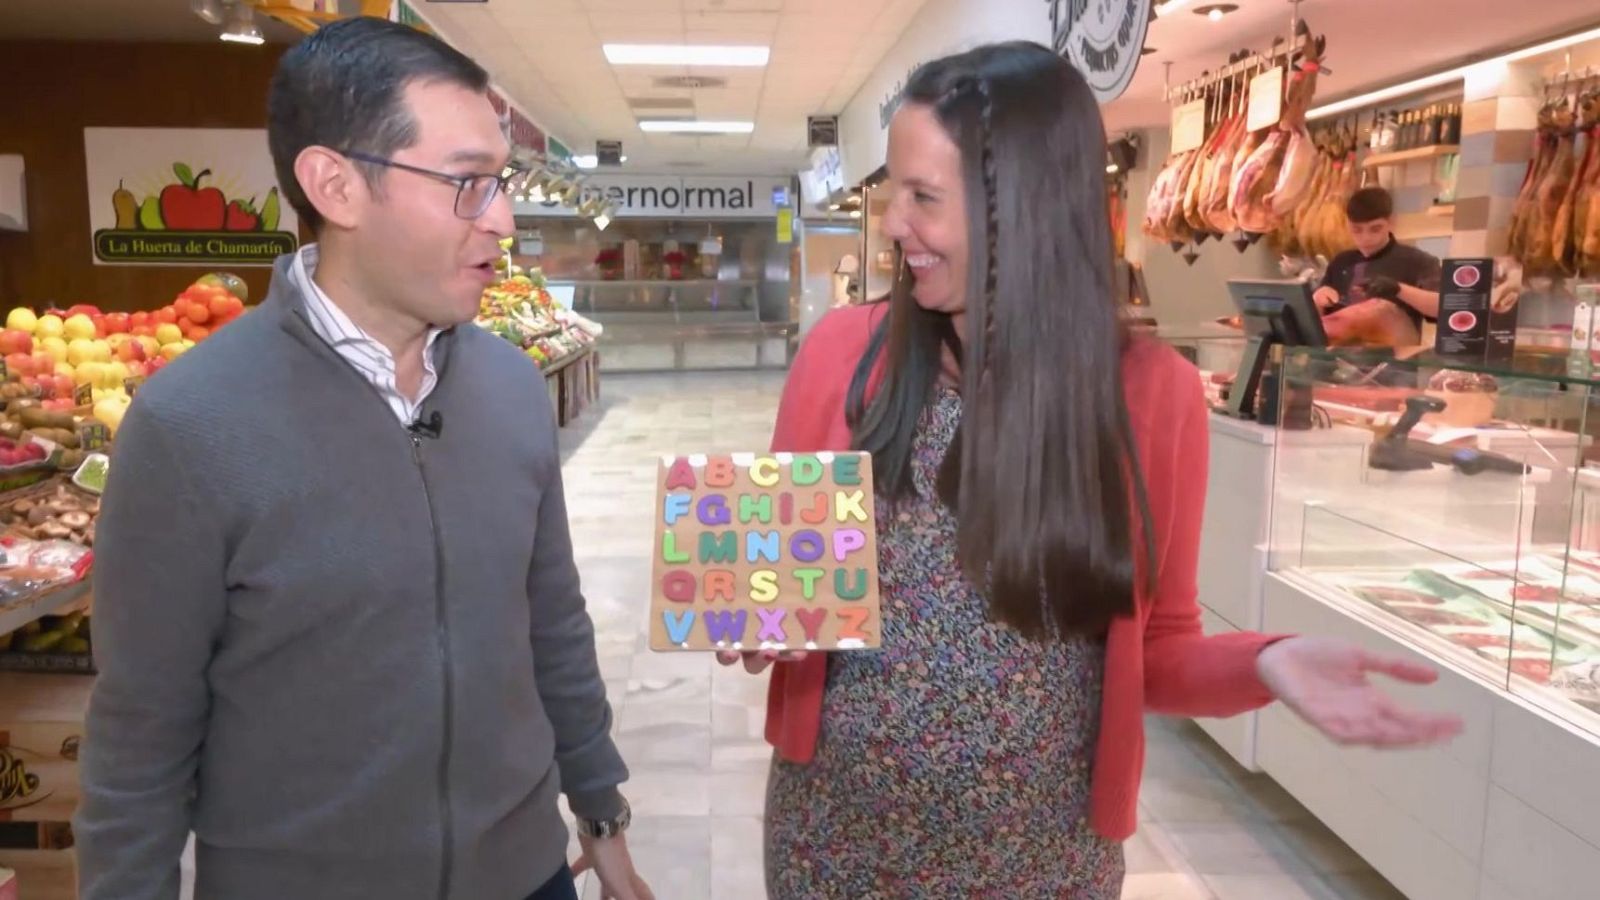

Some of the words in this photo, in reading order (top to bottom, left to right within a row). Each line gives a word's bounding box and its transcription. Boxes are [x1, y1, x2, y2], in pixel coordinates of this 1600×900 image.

[540, 180, 753, 209] pernormal
[109, 240, 128, 253] La
[132, 239, 182, 253] Huerta
[185, 240, 203, 253] de
[207, 239, 283, 254] Chamartín
